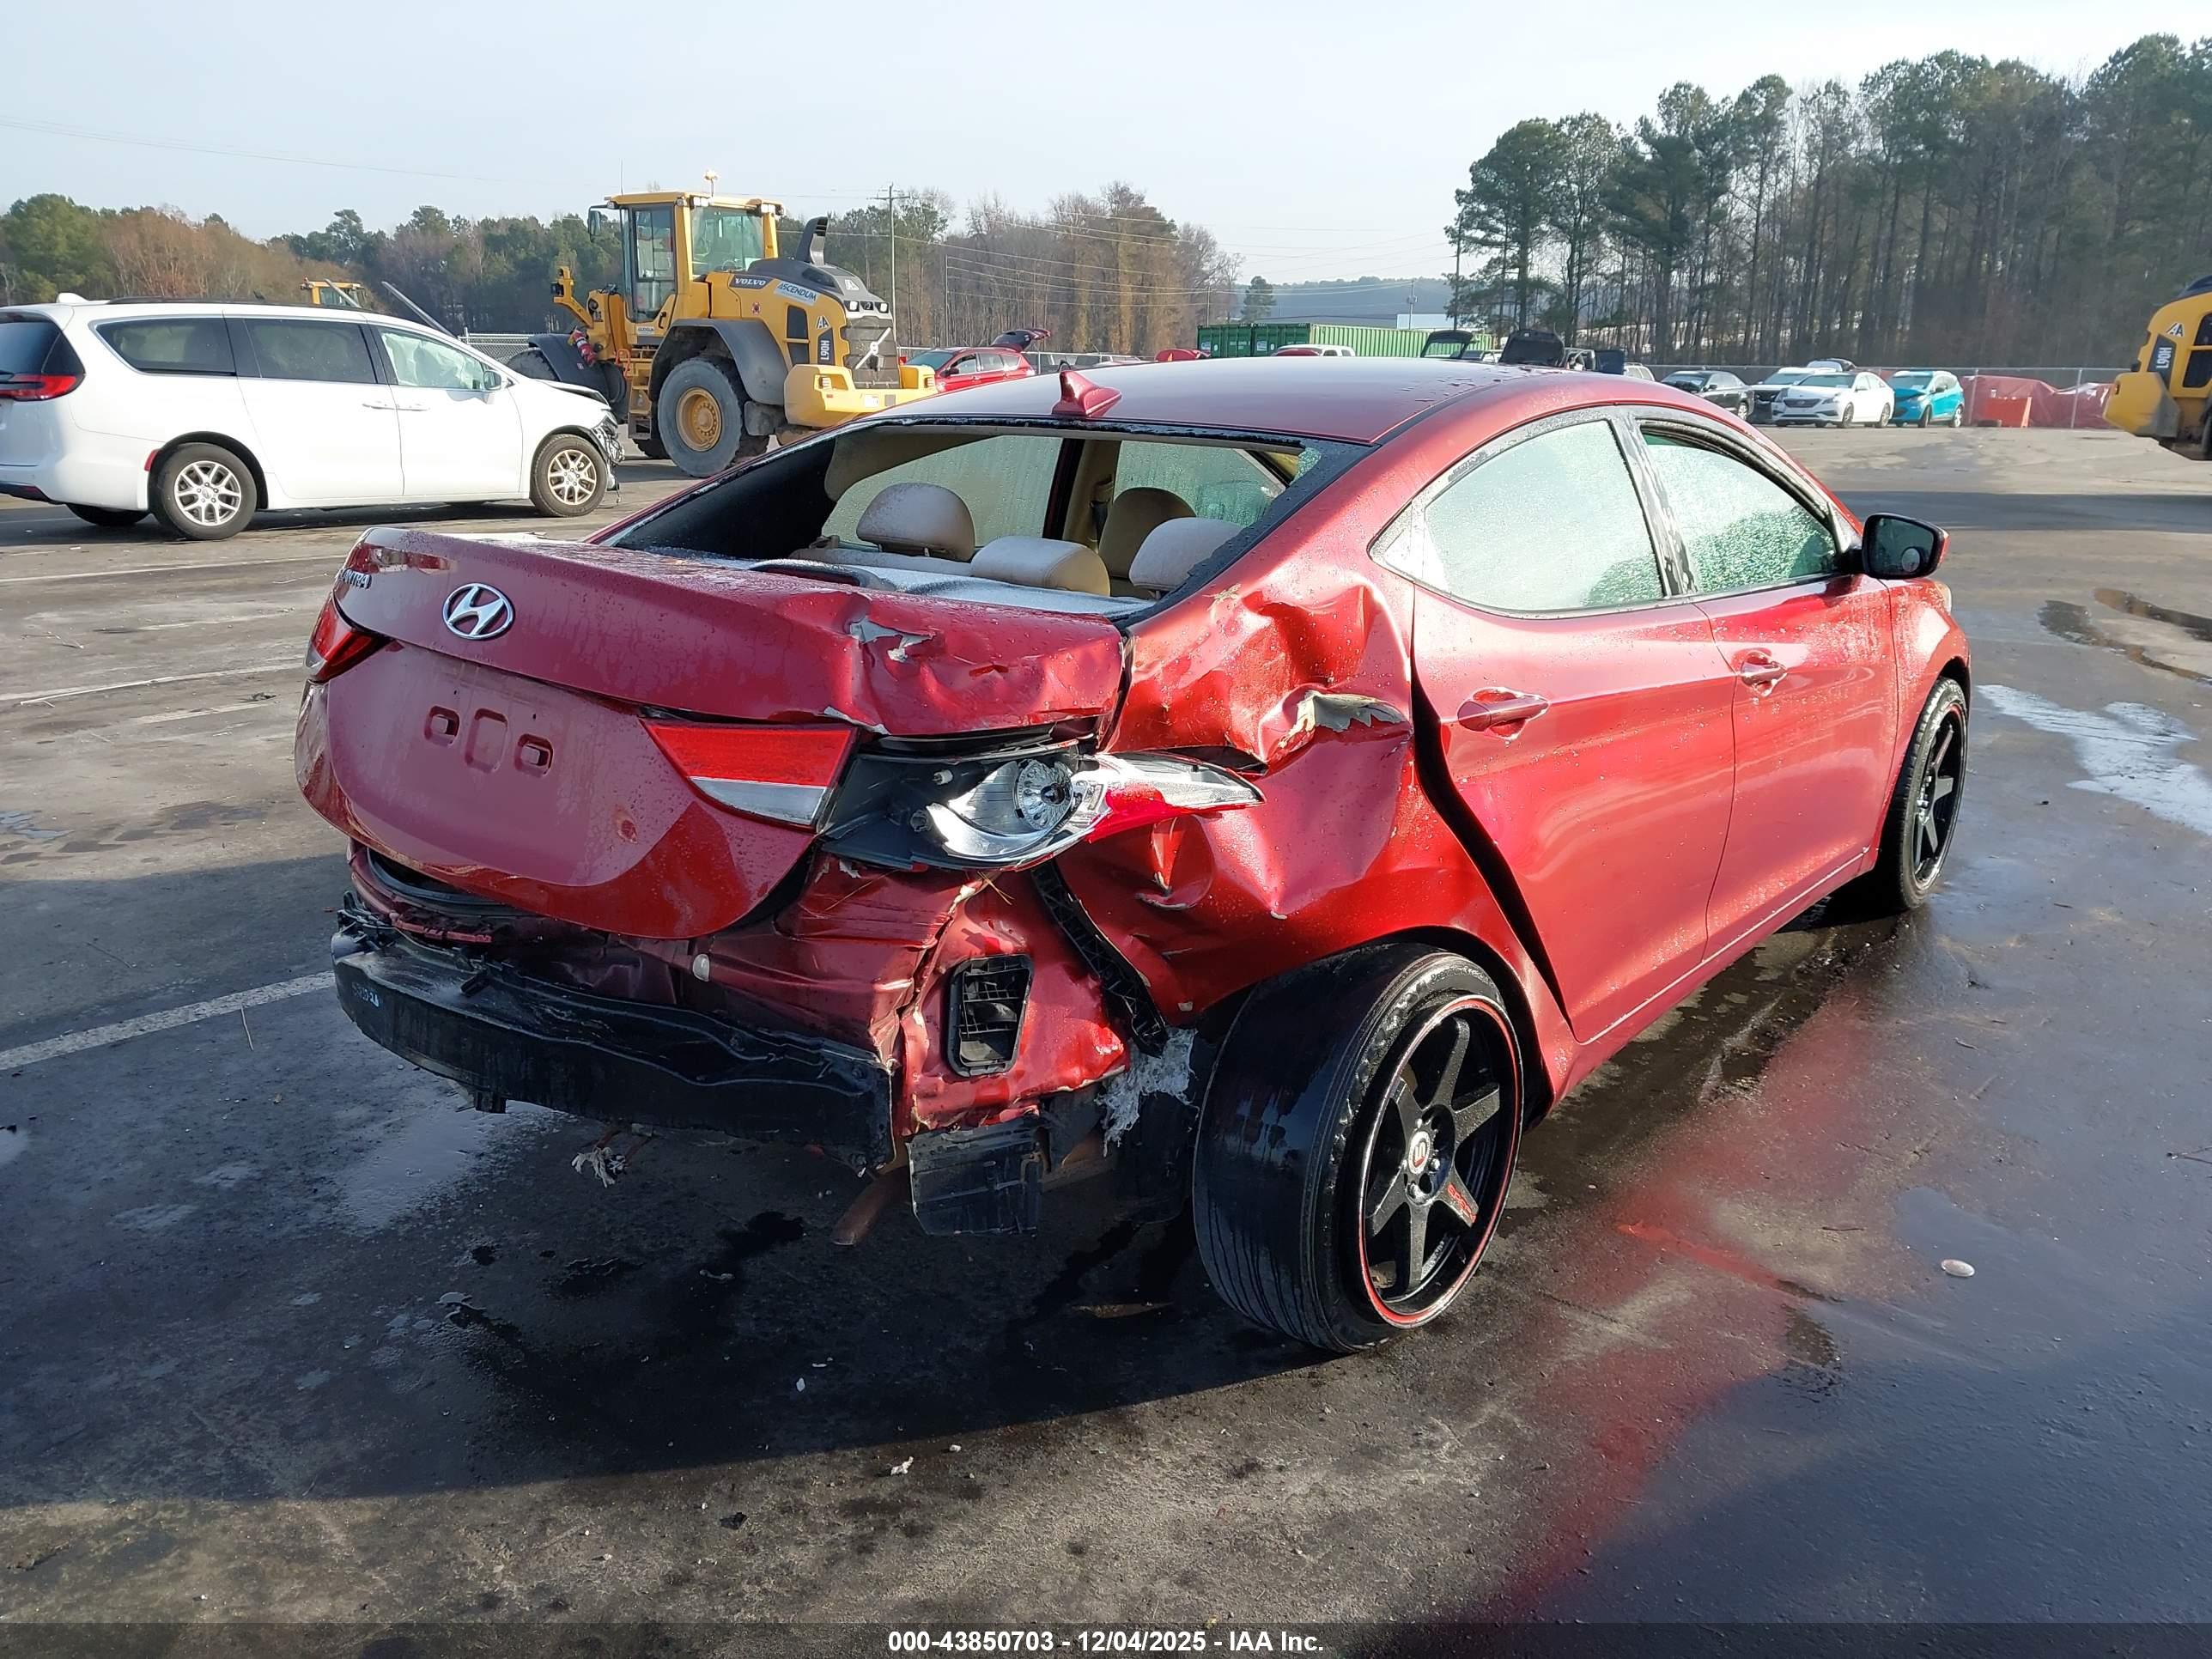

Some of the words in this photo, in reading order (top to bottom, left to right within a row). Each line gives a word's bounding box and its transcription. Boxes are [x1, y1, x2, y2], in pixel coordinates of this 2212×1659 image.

[735, 277, 766, 287] VOLVO
[777, 281, 817, 301] ASCENDUM
[820, 340, 830, 360] L90H
[2155, 347, 2172, 369] L90H
